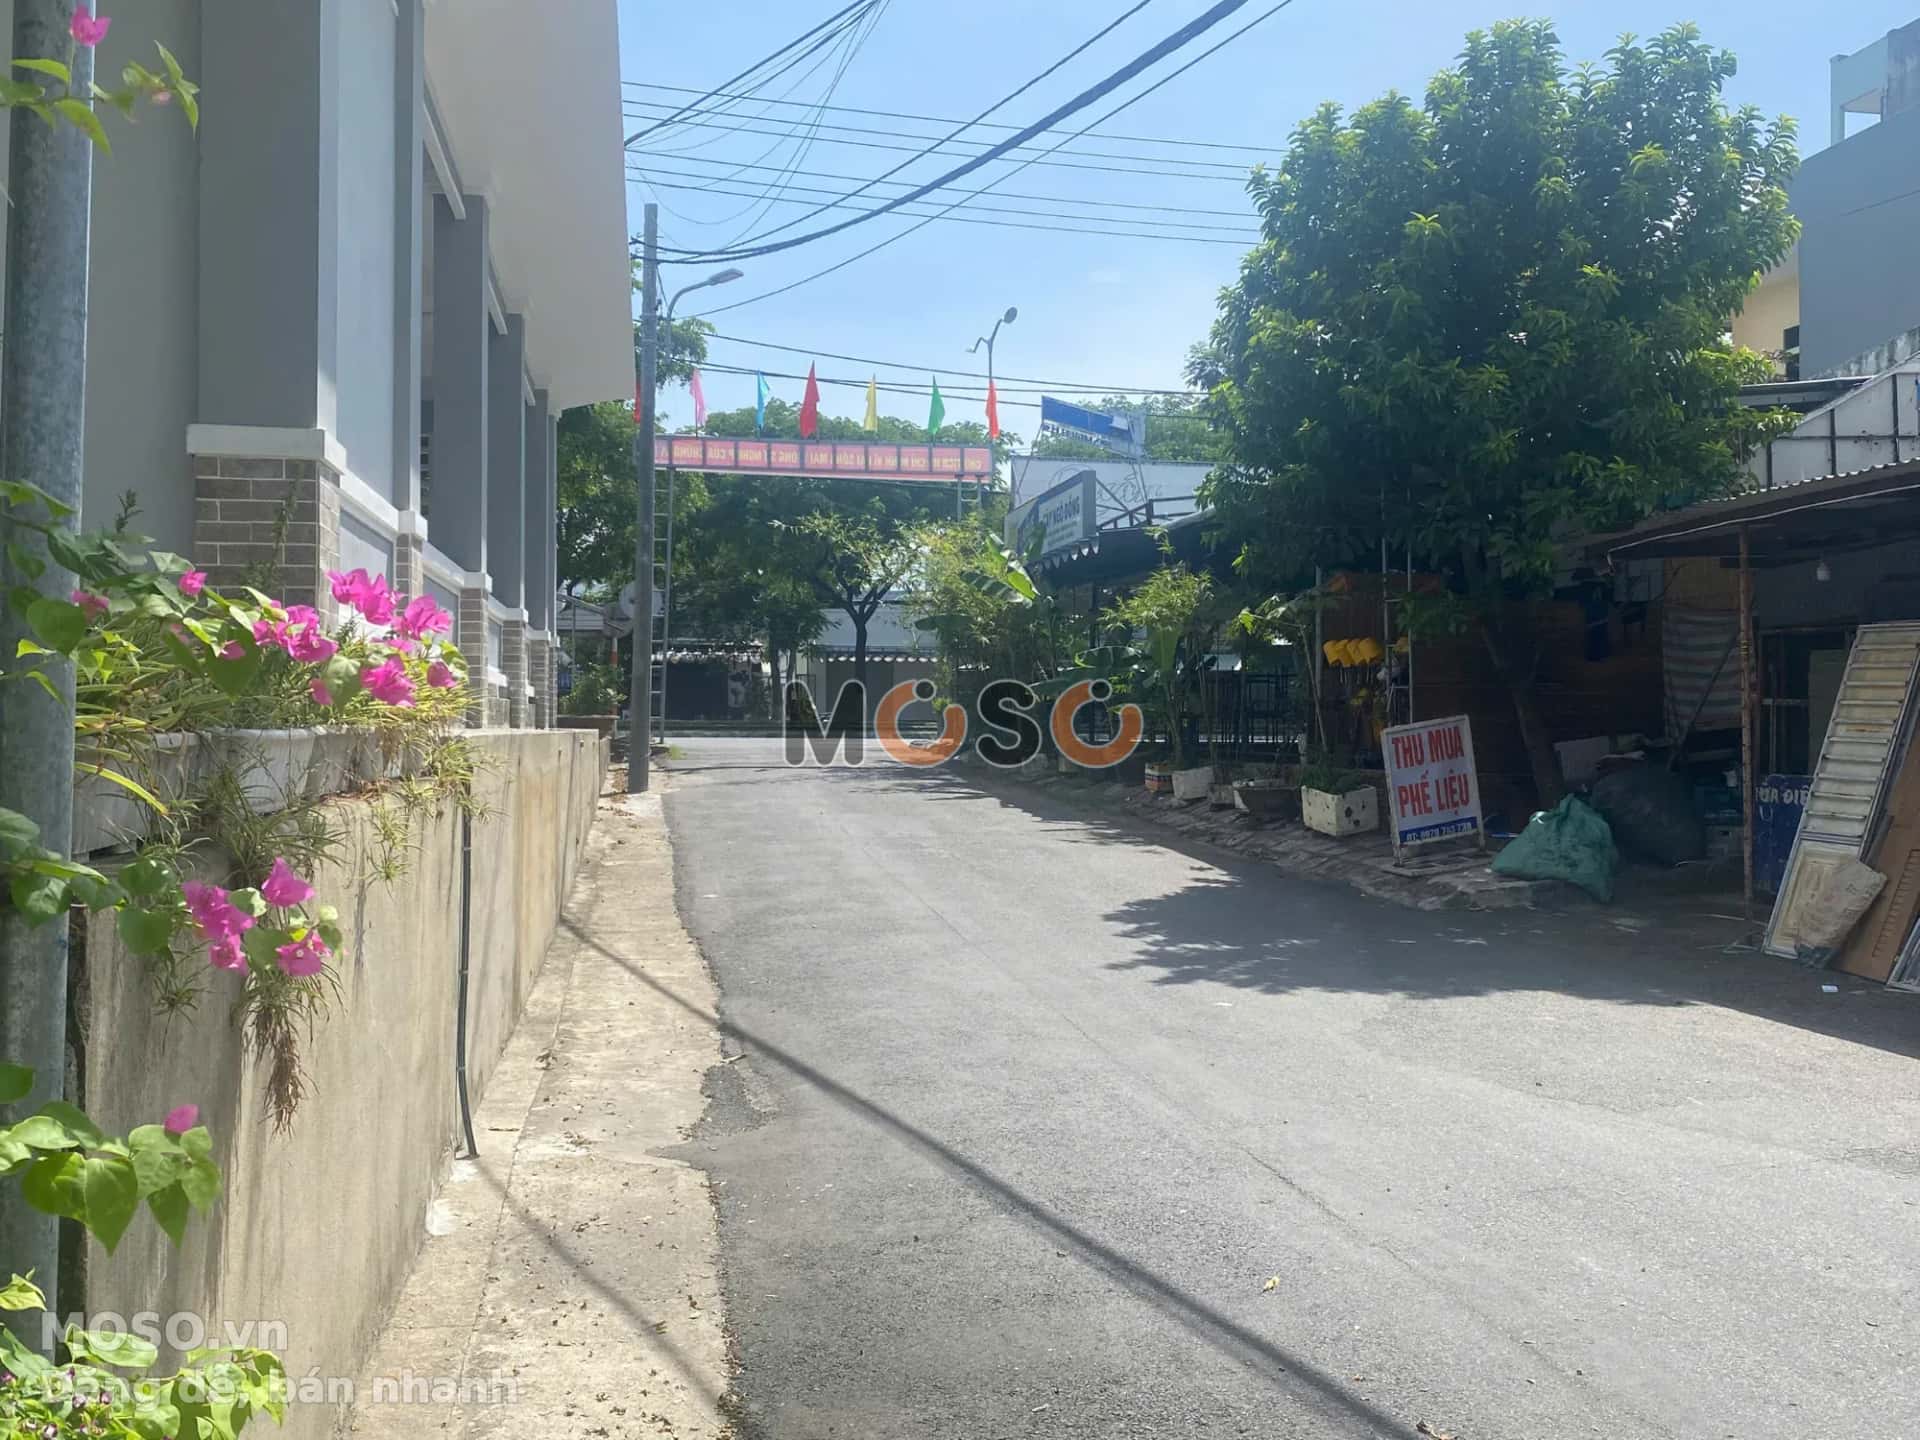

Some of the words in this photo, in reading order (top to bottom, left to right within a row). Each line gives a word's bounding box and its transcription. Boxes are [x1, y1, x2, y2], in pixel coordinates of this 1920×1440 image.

[1392, 733, 1425, 769] THU
[1427, 725, 1464, 763] MUA
[1397, 769, 1433, 818] PHẾ
[1435, 768, 1470, 817] LIỆU
